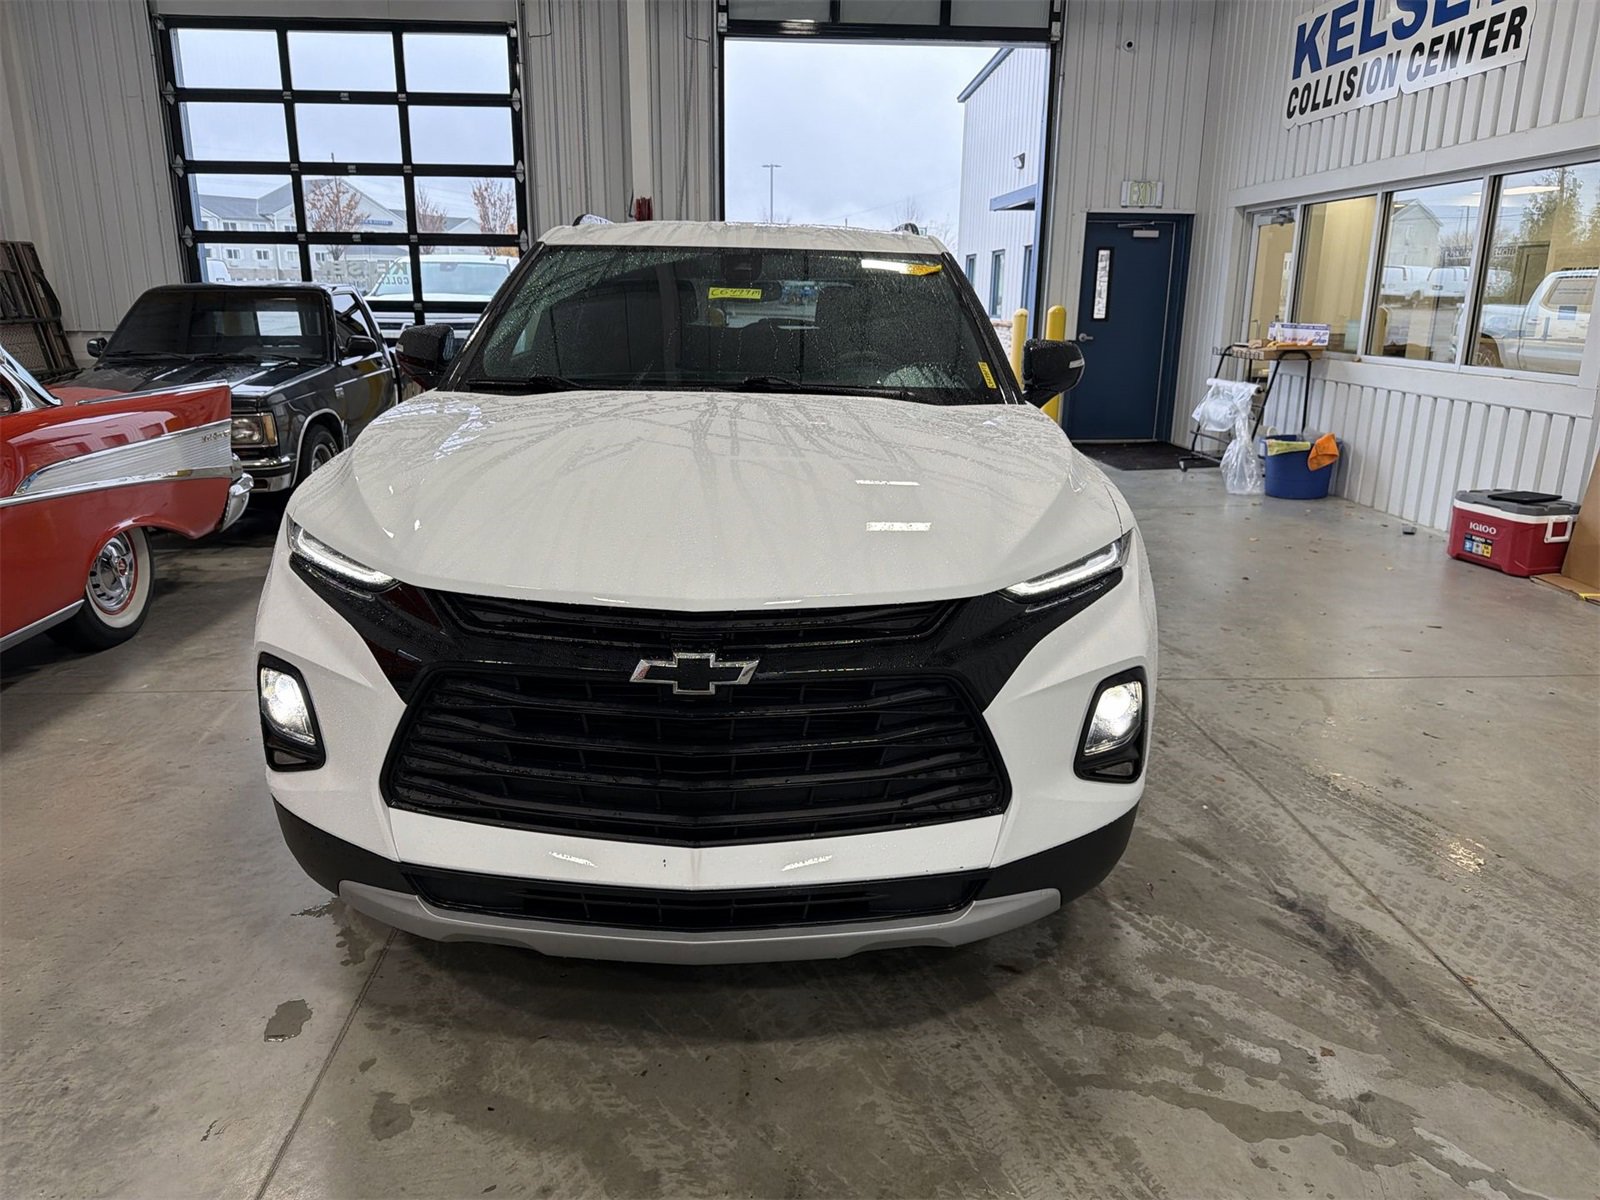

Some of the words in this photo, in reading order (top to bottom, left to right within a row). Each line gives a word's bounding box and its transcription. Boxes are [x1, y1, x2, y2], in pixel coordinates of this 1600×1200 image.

[1286, 50, 1401, 119] COLLISION
[1406, 5, 1528, 82] CENTER
[1129, 182, 1157, 205] EXIT
